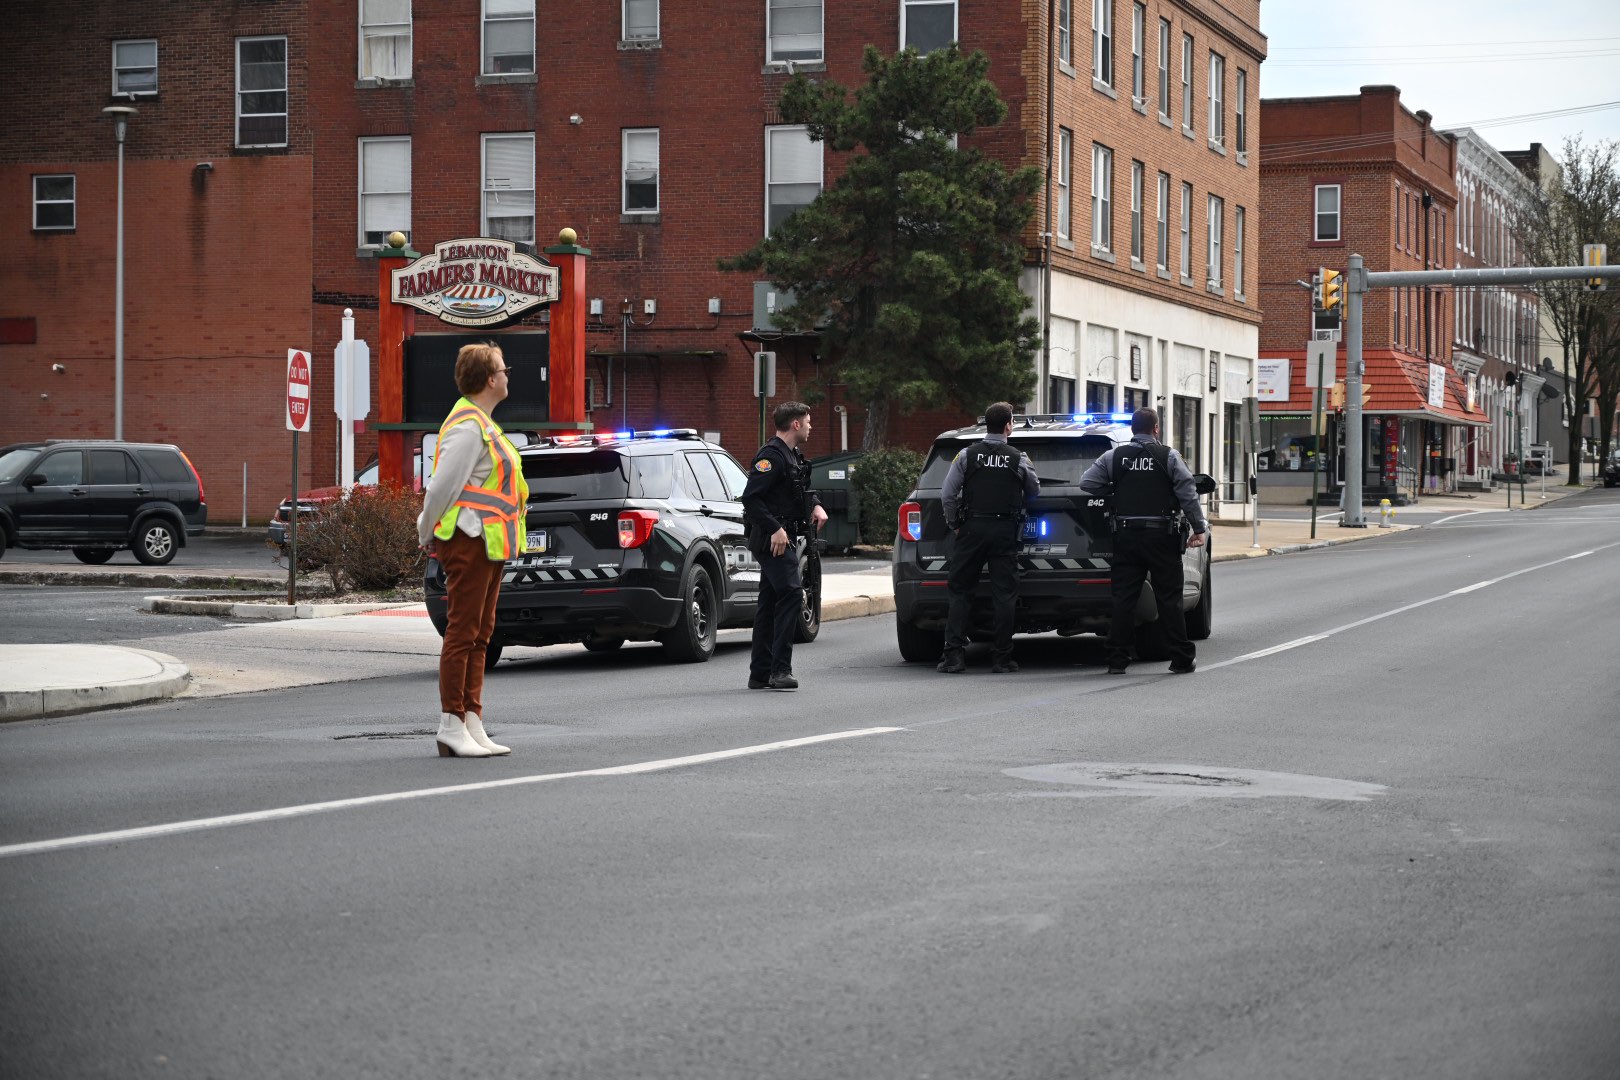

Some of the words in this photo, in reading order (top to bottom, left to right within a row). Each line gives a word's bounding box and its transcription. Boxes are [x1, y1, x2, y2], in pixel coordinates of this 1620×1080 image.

[439, 244, 510, 263] LEBANON
[398, 263, 476, 298] FARMERS
[478, 263, 552, 296] MARKET
[290, 366, 298, 379] DO
[298, 368, 308, 380] NOT
[291, 401, 305, 414] ENTER
